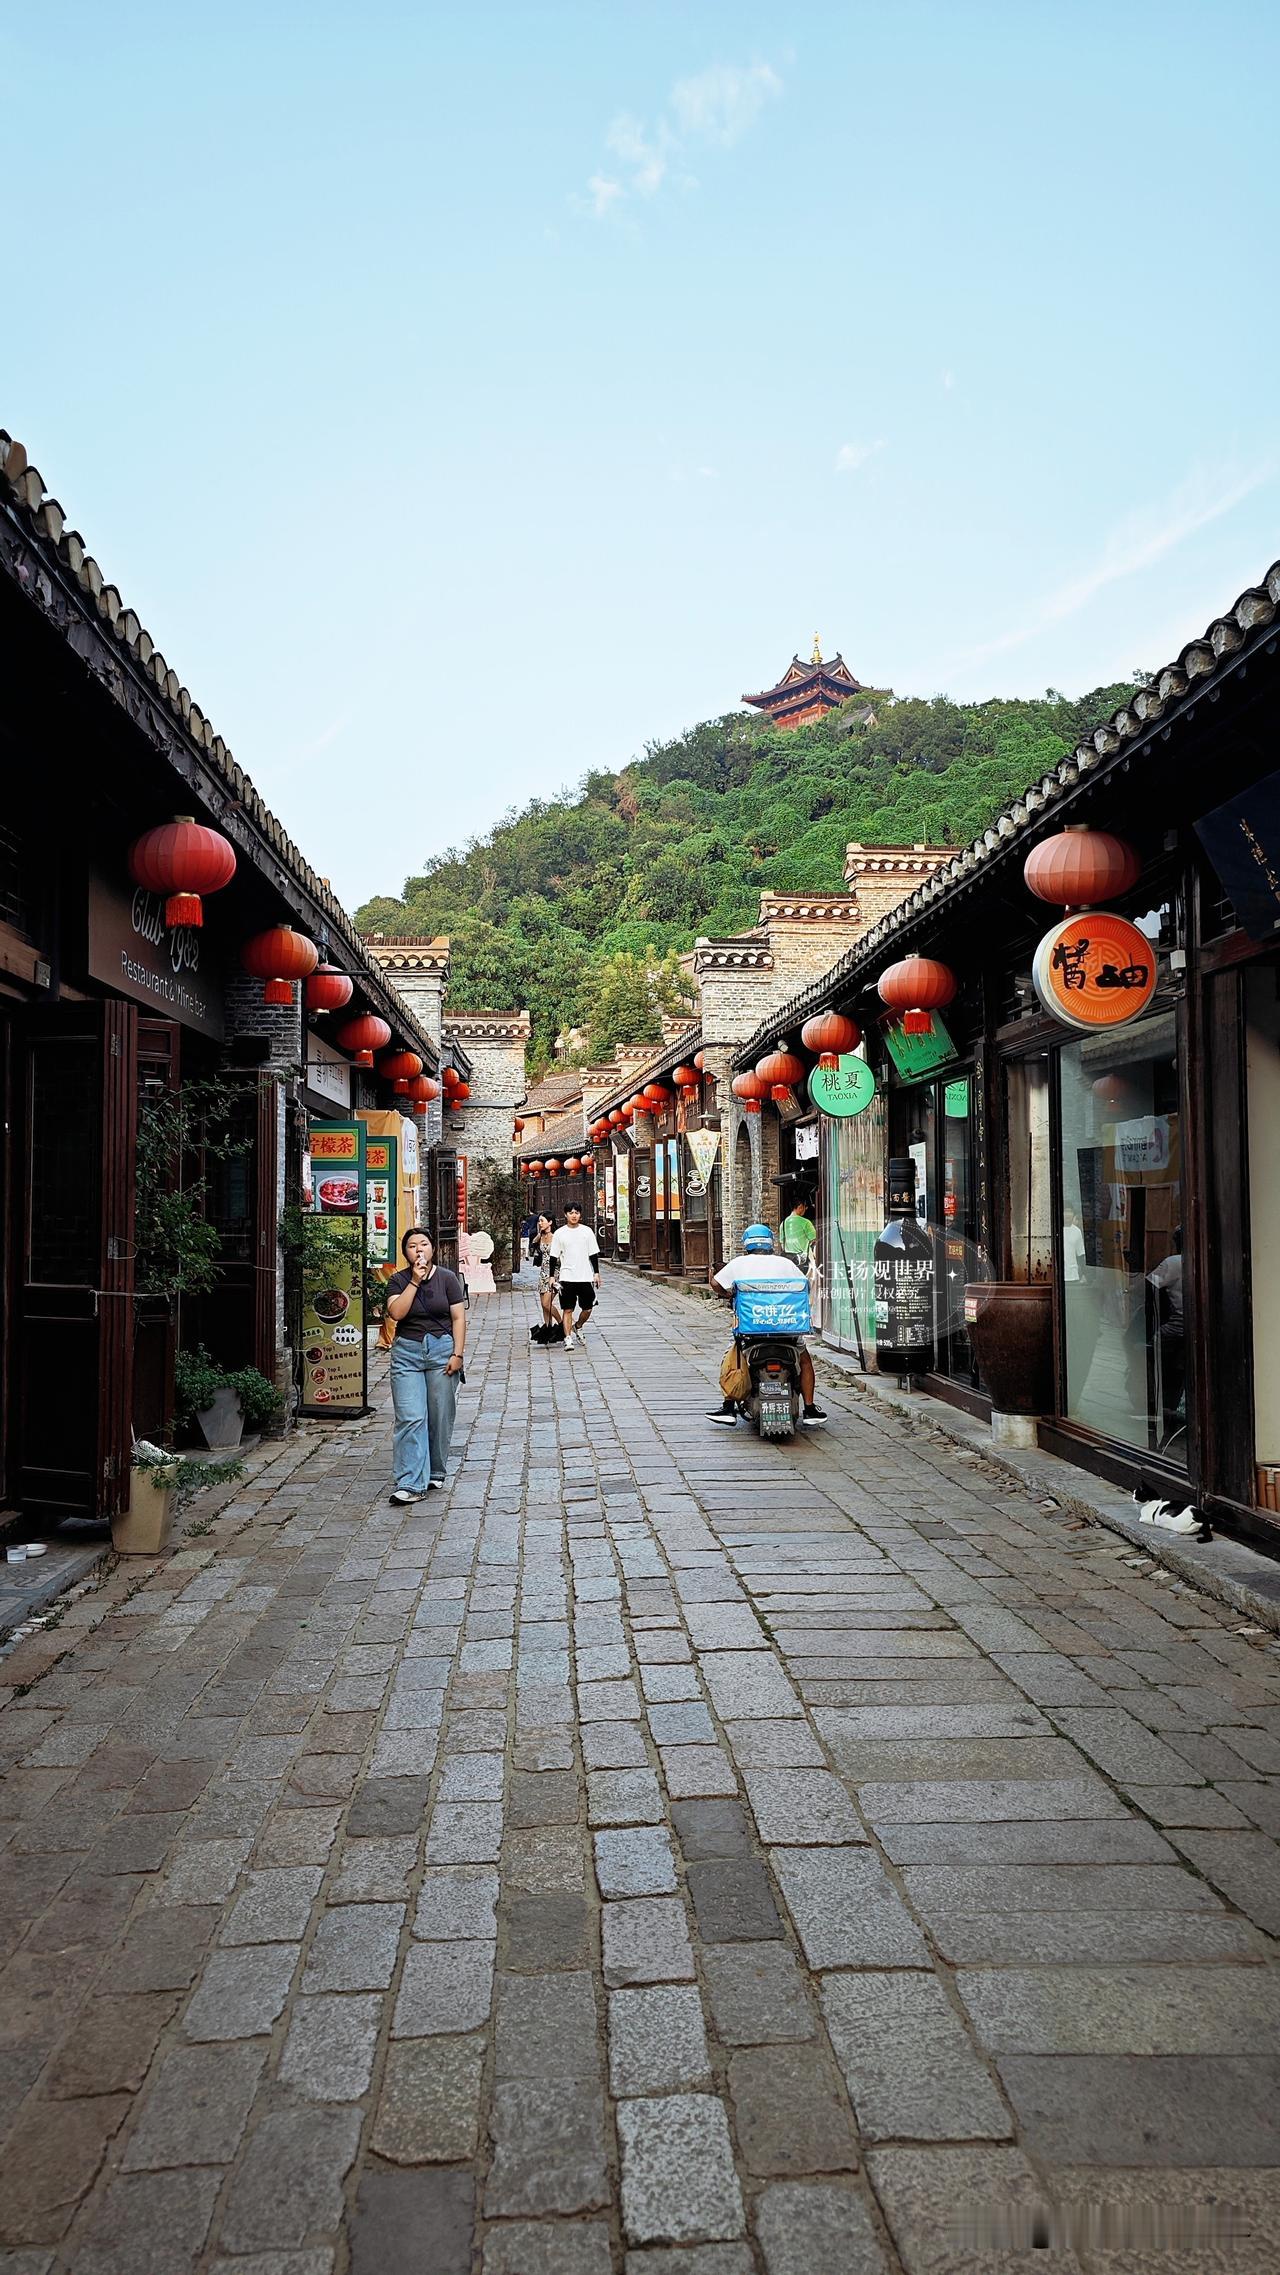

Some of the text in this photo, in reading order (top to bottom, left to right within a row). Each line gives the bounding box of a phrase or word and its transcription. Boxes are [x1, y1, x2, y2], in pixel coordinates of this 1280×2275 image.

[170, 927, 201, 973] 1982
[120, 950, 169, 998] Restaurant
[169, 979, 175, 1002] &
[821, 1069, 863, 1092] 桃夏
[827, 1092, 858, 1101] TAOXIA
